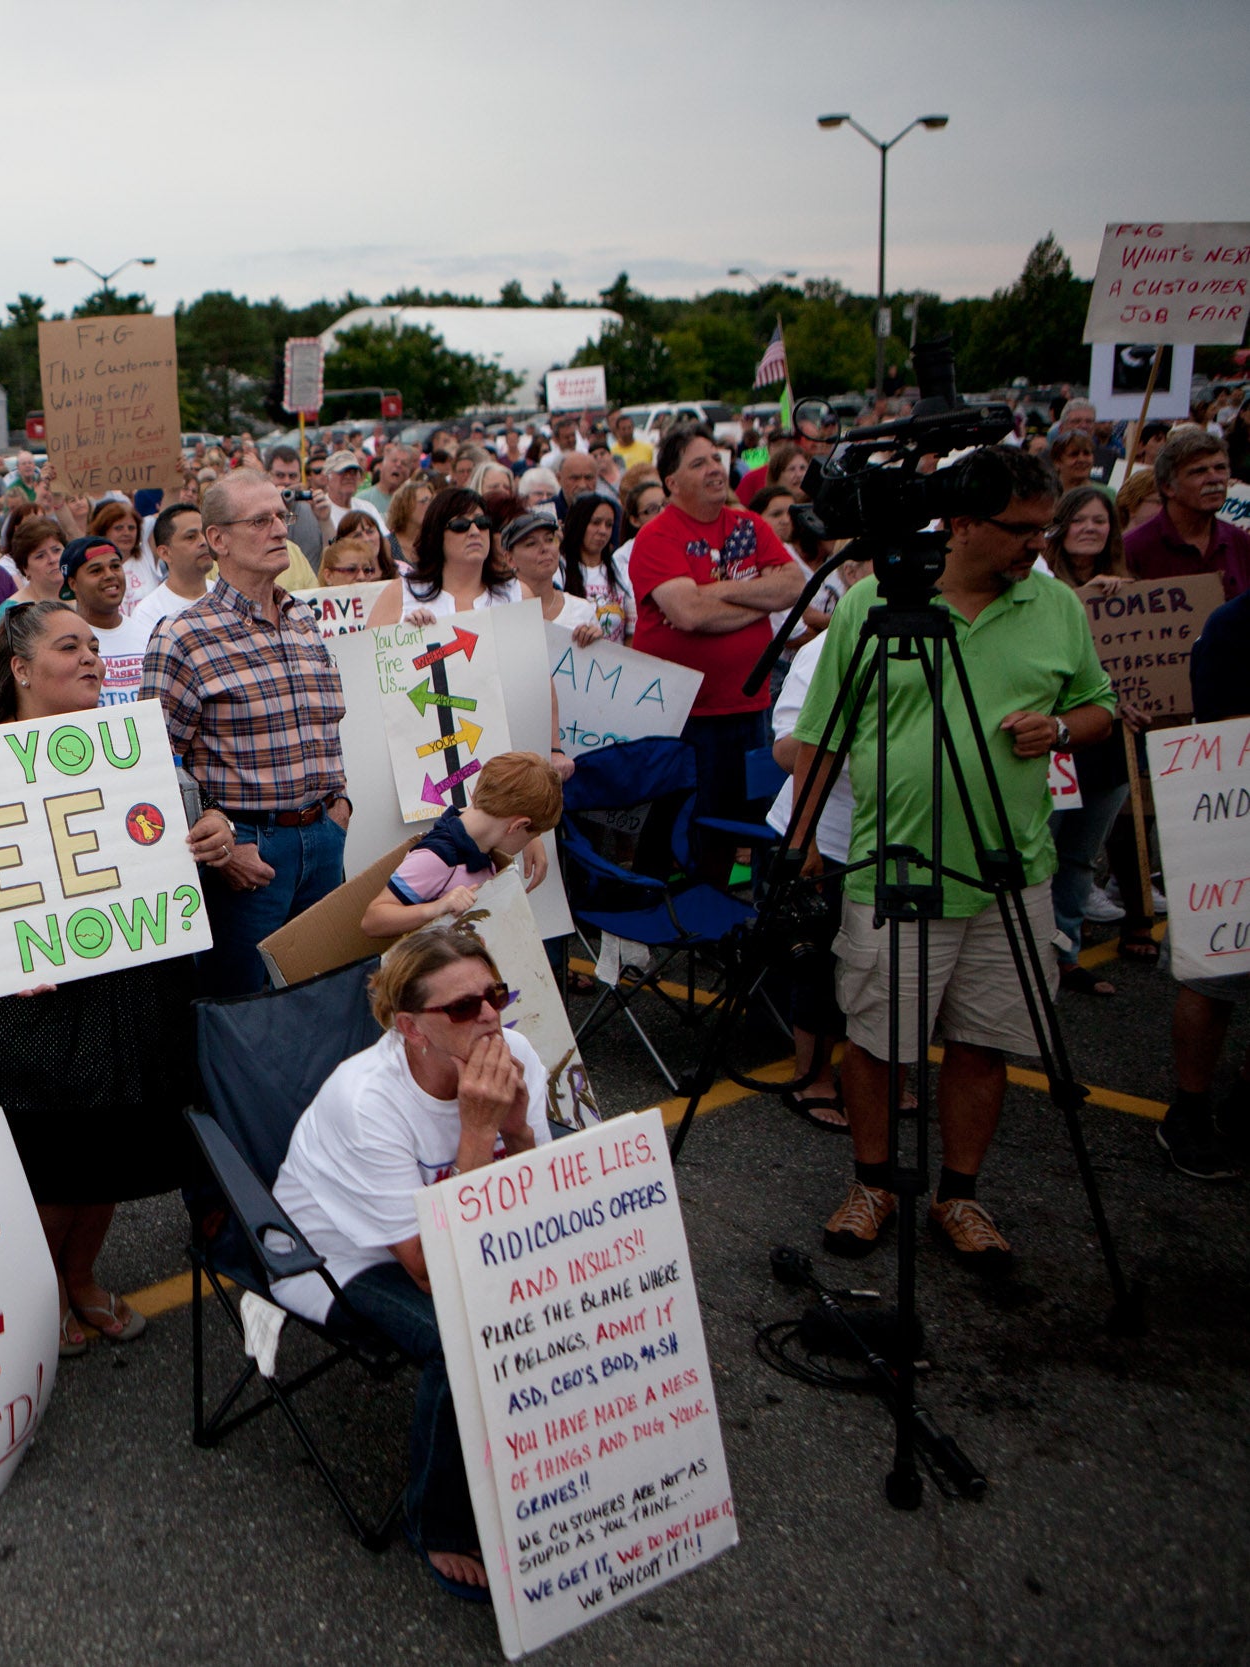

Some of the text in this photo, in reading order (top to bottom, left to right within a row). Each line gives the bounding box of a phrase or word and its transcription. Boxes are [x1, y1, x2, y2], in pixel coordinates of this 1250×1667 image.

[1121, 244, 1193, 270] WHAT'S
[1109, 279, 1248, 297] A CUSTOMER
[1120, 303, 1243, 324] JOB FAIR
[46, 361, 86, 385] This
[76, 403, 156, 433] LETTER
[68, 465, 156, 489] WE QUIT
[307, 597, 364, 621] SAVE
[1085, 587, 1194, 620] TOMER
[371, 626, 393, 650] You
[375, 650, 404, 675] Fire
[551, 646, 665, 713] AM A
[1100, 651, 1191, 674] ETBASKET
[1111, 676, 1149, 689] NTIL
[4, 716, 142, 784] YOU
[428, 734, 458, 752] YOUR
[1159, 733, 1221, 776] I'M
[14, 884, 201, 974] NOW?
[457, 1164, 534, 1223] STOP
[548, 1151, 592, 1193] THE
[478, 1180, 667, 1267] RIDICOLOUS OFFERS
[508, 1228, 646, 1304] AND INSULTS!!
[481, 1260, 681, 1349] PLACE THE BLAME WHERE
[493, 1354, 508, 1383] IT
[595, 1307, 647, 1344] ADMIT
[656, 1296, 674, 1327] IT
[505, 1367, 699, 1461] YOU HAVE MADE A MESS
[510, 1466, 530, 1493] OF
[535, 1446, 592, 1483] THINGS
[597, 1431, 628, 1459] AND
[633, 1417, 666, 1443] DUG
[518, 1457, 708, 1552] WE CUSTOMERS ARE NOT AS
[519, 1541, 570, 1575] STUPID
[575, 1529, 594, 1548] AS
[600, 1517, 627, 1541] YOU
[523, 1577, 554, 1604] WE
[558, 1564, 590, 1591] GET
[616, 1543, 643, 1566] WE
[648, 1532, 663, 1548] DO
[665, 1515, 690, 1541] NOT
[694, 1502, 720, 1529] LIKE
[578, 1589, 605, 1611] WE
[609, 1557, 663, 1593] BOYCOTT
